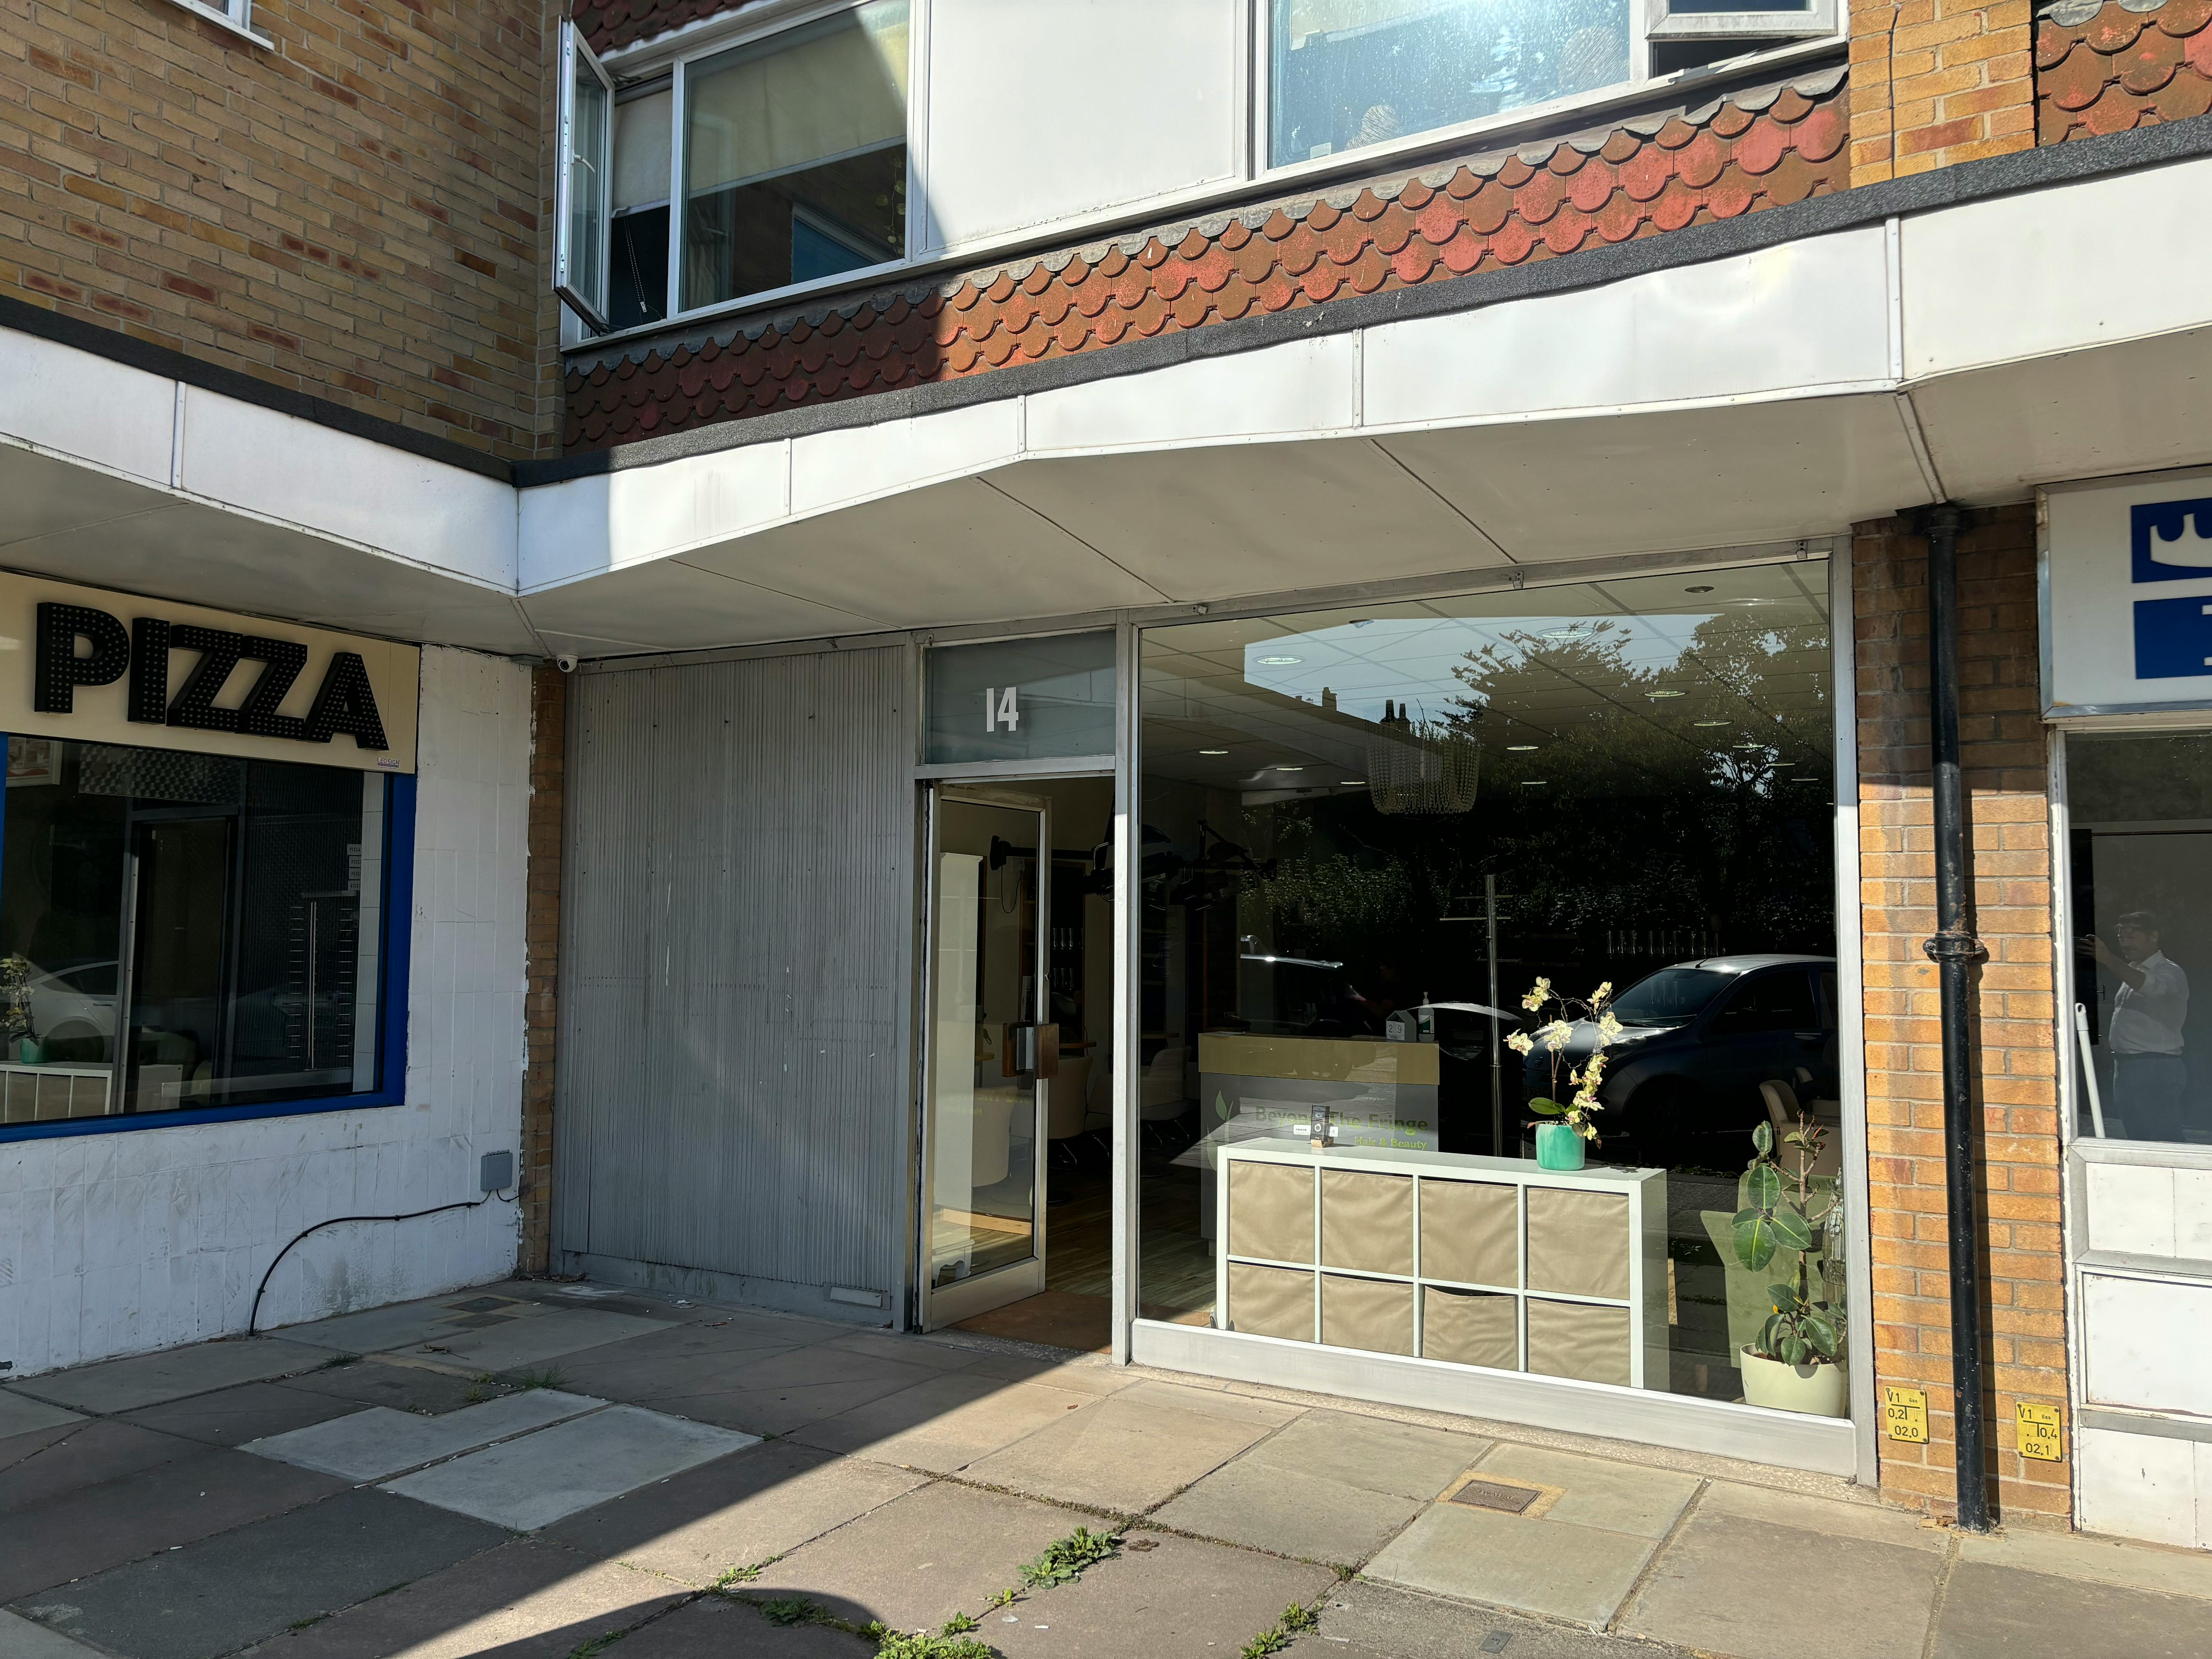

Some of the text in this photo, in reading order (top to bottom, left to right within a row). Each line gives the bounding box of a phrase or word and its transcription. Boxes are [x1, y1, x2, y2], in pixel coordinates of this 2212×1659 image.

[34, 602, 389, 750] PIZZA
[986, 687, 1018, 732] 14
[1256, 1106, 1428, 1136] Beyon The Fringe
[1355, 1137, 1427, 1150] Hair & Beauty
[1887, 1391, 1899, 1403] V1
[2018, 1408, 2032, 1419] V1
